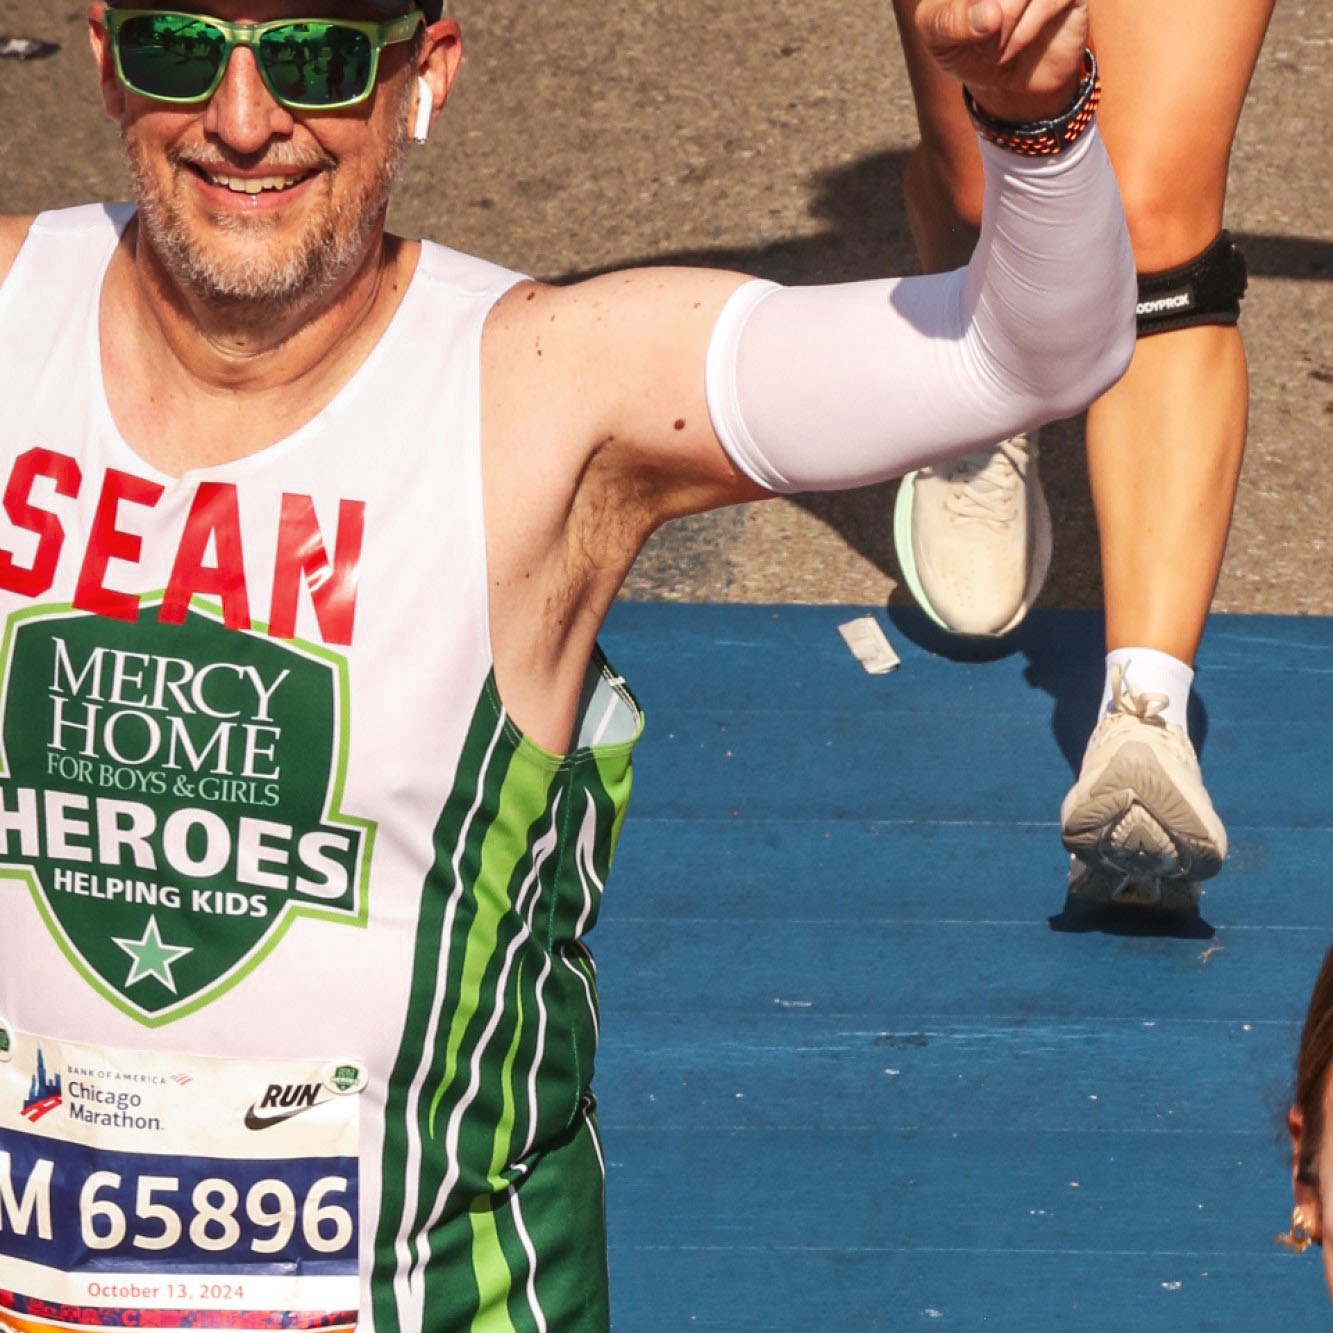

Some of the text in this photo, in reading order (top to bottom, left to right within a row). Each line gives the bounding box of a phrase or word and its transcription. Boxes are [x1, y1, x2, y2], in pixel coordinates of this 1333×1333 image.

[1136, 293, 1190, 315] ODYPROX
[0, 447, 366, 646] SEAN
[48, 637, 290, 722] MERCY
[46, 695, 282, 779] HOME
[46, 752, 281, 807] FOR BOYS & GIRLS
[0, 787, 351, 900] HEROES
[53, 867, 269, 919] HELPING KIDS
[67, 1065, 167, 1085] BANK OF AMERICA
[68, 1081, 142, 1110] Chicago
[261, 1082, 323, 1108] RUN
[69, 1102, 161, 1131] Marathon
[0, 1150, 354, 1254] M 65896
[88, 1282, 245, 1300] October 13, 2024
